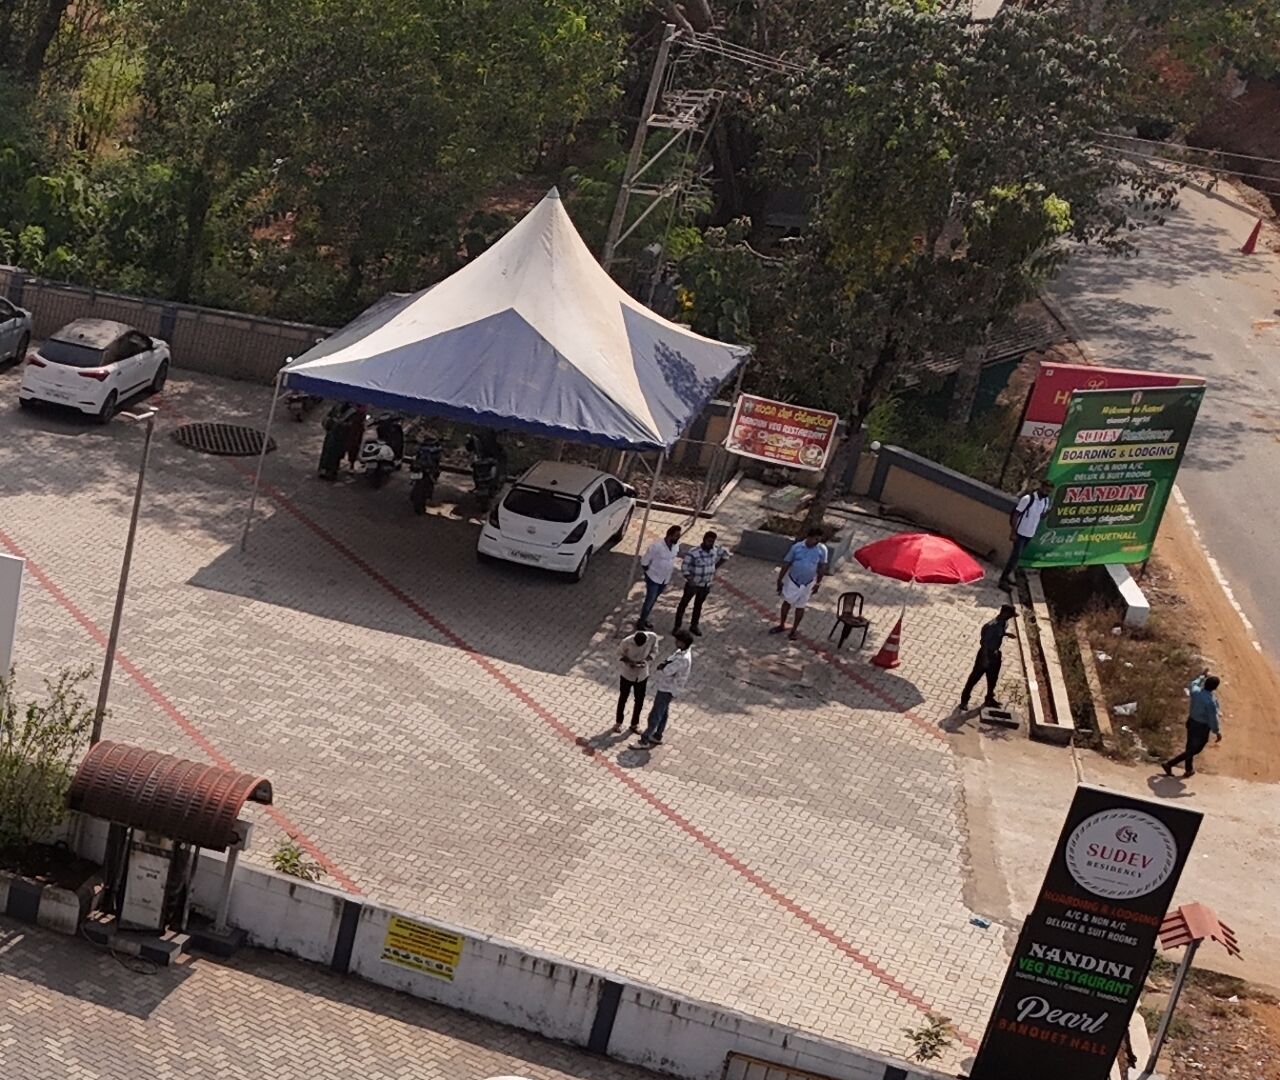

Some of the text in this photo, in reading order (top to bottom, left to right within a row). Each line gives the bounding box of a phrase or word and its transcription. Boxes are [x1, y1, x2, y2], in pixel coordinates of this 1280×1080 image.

[1075, 429, 1123, 443] SUDEV
[1062, 447, 1116, 461] BOARDING
[1128, 446, 1175, 458] LODGING
[1129, 462, 1144, 470] A/C
[1063, 484, 1148, 503] NANDINI
[1057, 503, 1143, 516] VEG RESTAURANT
[1086, 843, 1154, 869] SUDEV
[1086, 860, 1142, 879] RESIDENCY
[1045, 916, 1138, 946] DELUXE & SUIT ROOMS
[1065, 909, 1127, 932] A/C & NON A/C
[1028, 942, 1134, 980] NANDINI
[1018, 957, 1134, 996] VEG RESTAURANT
[1016, 995, 1109, 1034] Pearl
[1000, 1018, 1108, 1056] BANQUET HALL
